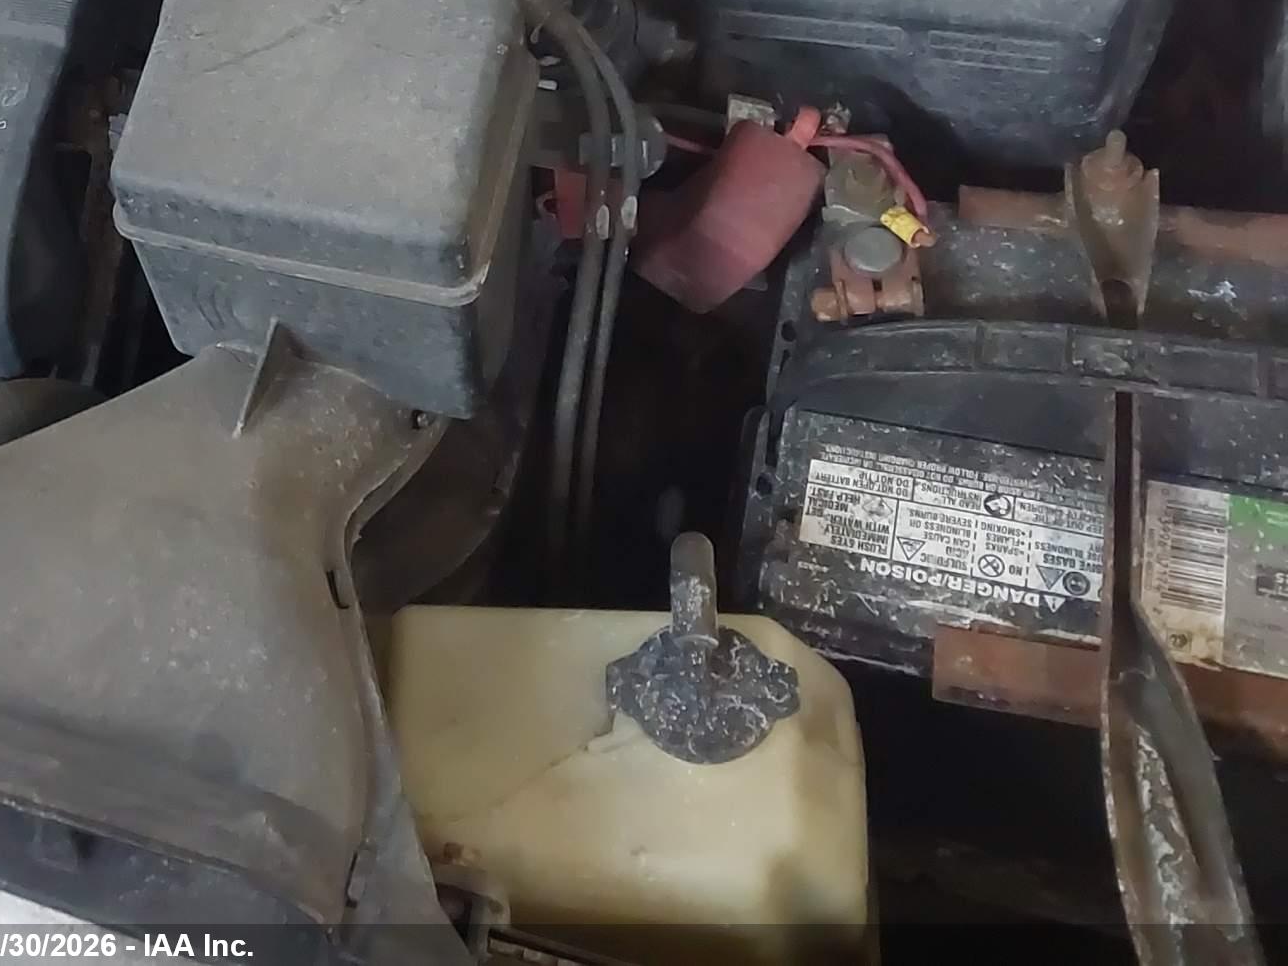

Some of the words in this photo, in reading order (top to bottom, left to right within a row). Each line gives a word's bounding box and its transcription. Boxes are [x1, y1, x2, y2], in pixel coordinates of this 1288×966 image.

[815, 471, 850, 485] BATTERY
[851, 478, 875, 490] OPEN
[875, 474, 894, 484] NOT
[896, 477, 909, 487] DO
[876, 483, 894, 493] NOT
[895, 487, 908, 496] DO
[806, 496, 849, 512] MEDICAL
[835, 491, 861, 504] HELP
[941, 496, 956, 507] ALL
[804, 505, 824, 517] GET
[958, 499, 980, 510] READ
[864, 520, 890, 534] WITH
[908, 518, 922, 527] OR
[923, 520, 970, 537] BLINDNESS
[829, 534, 855, 548] EYES
[921, 530, 951, 544] CAUSE
[951, 536, 970, 547] CAN
[856, 541, 887, 555] FLUSH
[944, 545, 969, 559] ACID
[1033, 541, 1083, 558] BLINDNESS
[1041, 552, 1076, 568] GASES
[1008, 564, 1023, 575] NO
[858, 557, 1040, 606] DANGER/POISON
